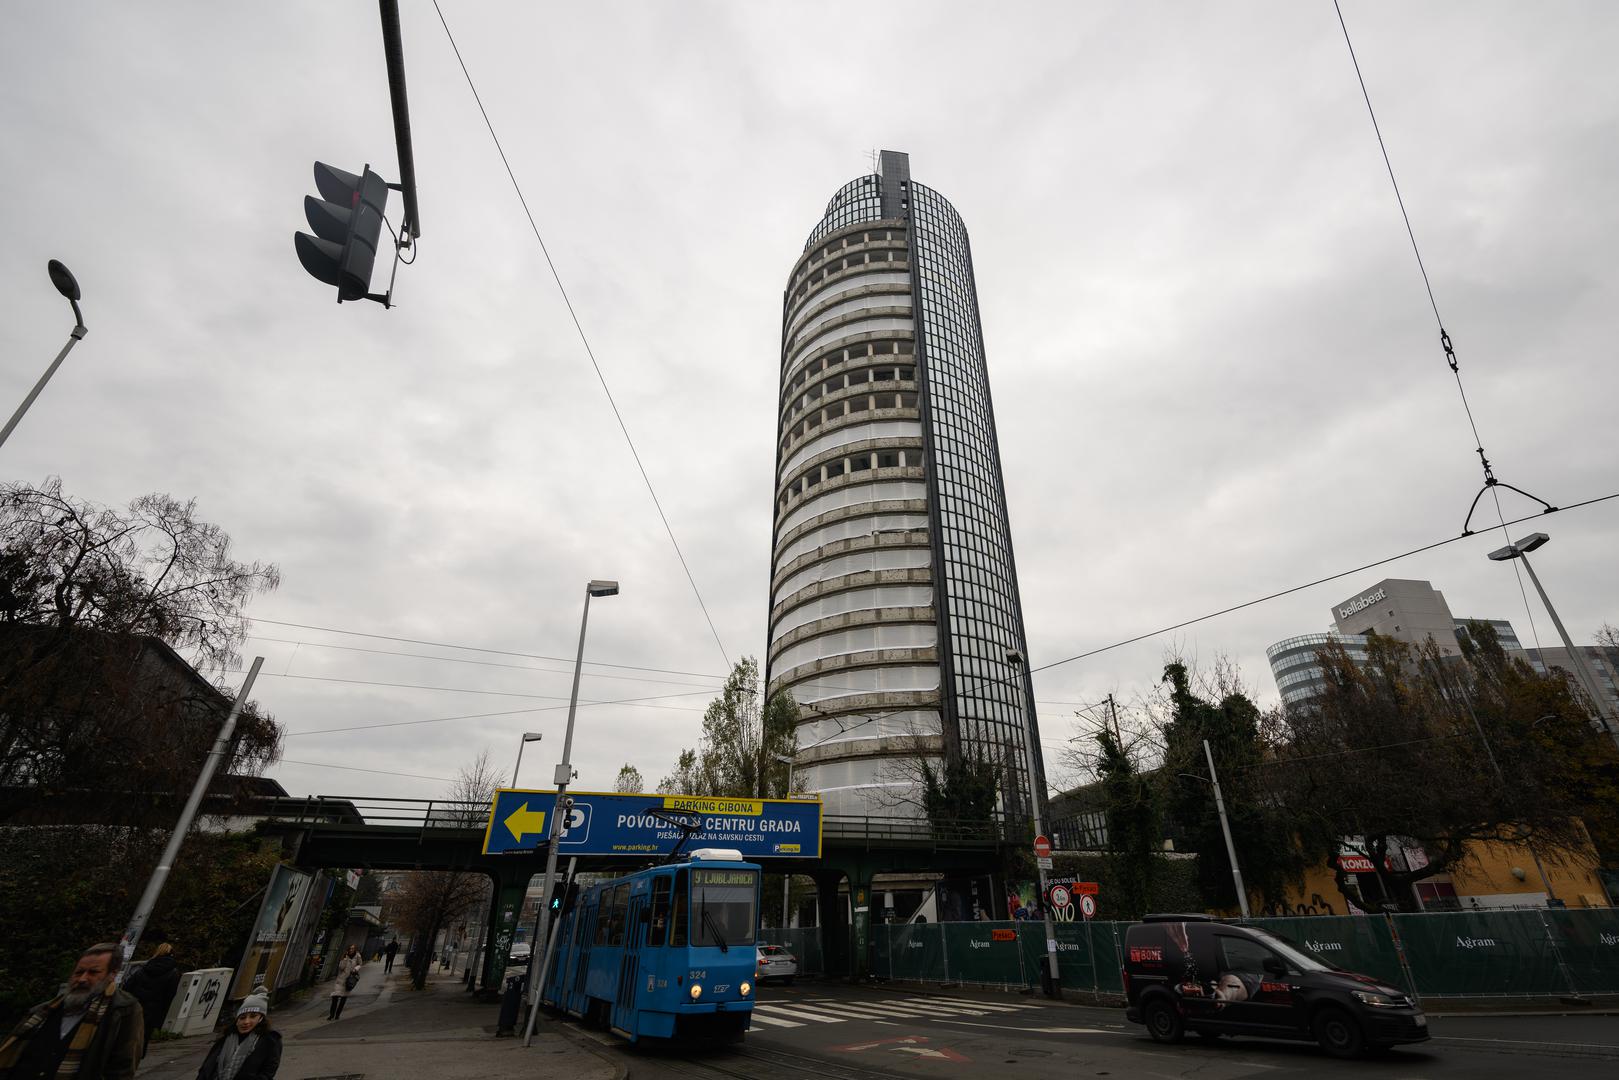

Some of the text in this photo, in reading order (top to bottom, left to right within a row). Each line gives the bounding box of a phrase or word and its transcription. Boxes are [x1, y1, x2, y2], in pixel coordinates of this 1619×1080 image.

[1338, 588, 1386, 619] bellabeat
[674, 801, 753, 812] PARKING CIBONA
[705, 818, 755, 831] CENTRU
[759, 820, 801, 833] GRADA
[707, 833, 717, 841] NA
[718, 833, 743, 841] SAVSKU
[744, 834, 765, 842] CESTU
[613, 844, 658, 852] www.parking.hr
[1341, 858, 1379, 870] KONZU
[695, 871, 701, 884] 9
[969, 939, 990, 949] Agram
[1304, 939, 1342, 953] Agram
[1456, 936, 1496, 949] Agram
[689, 970, 706, 980] 324
